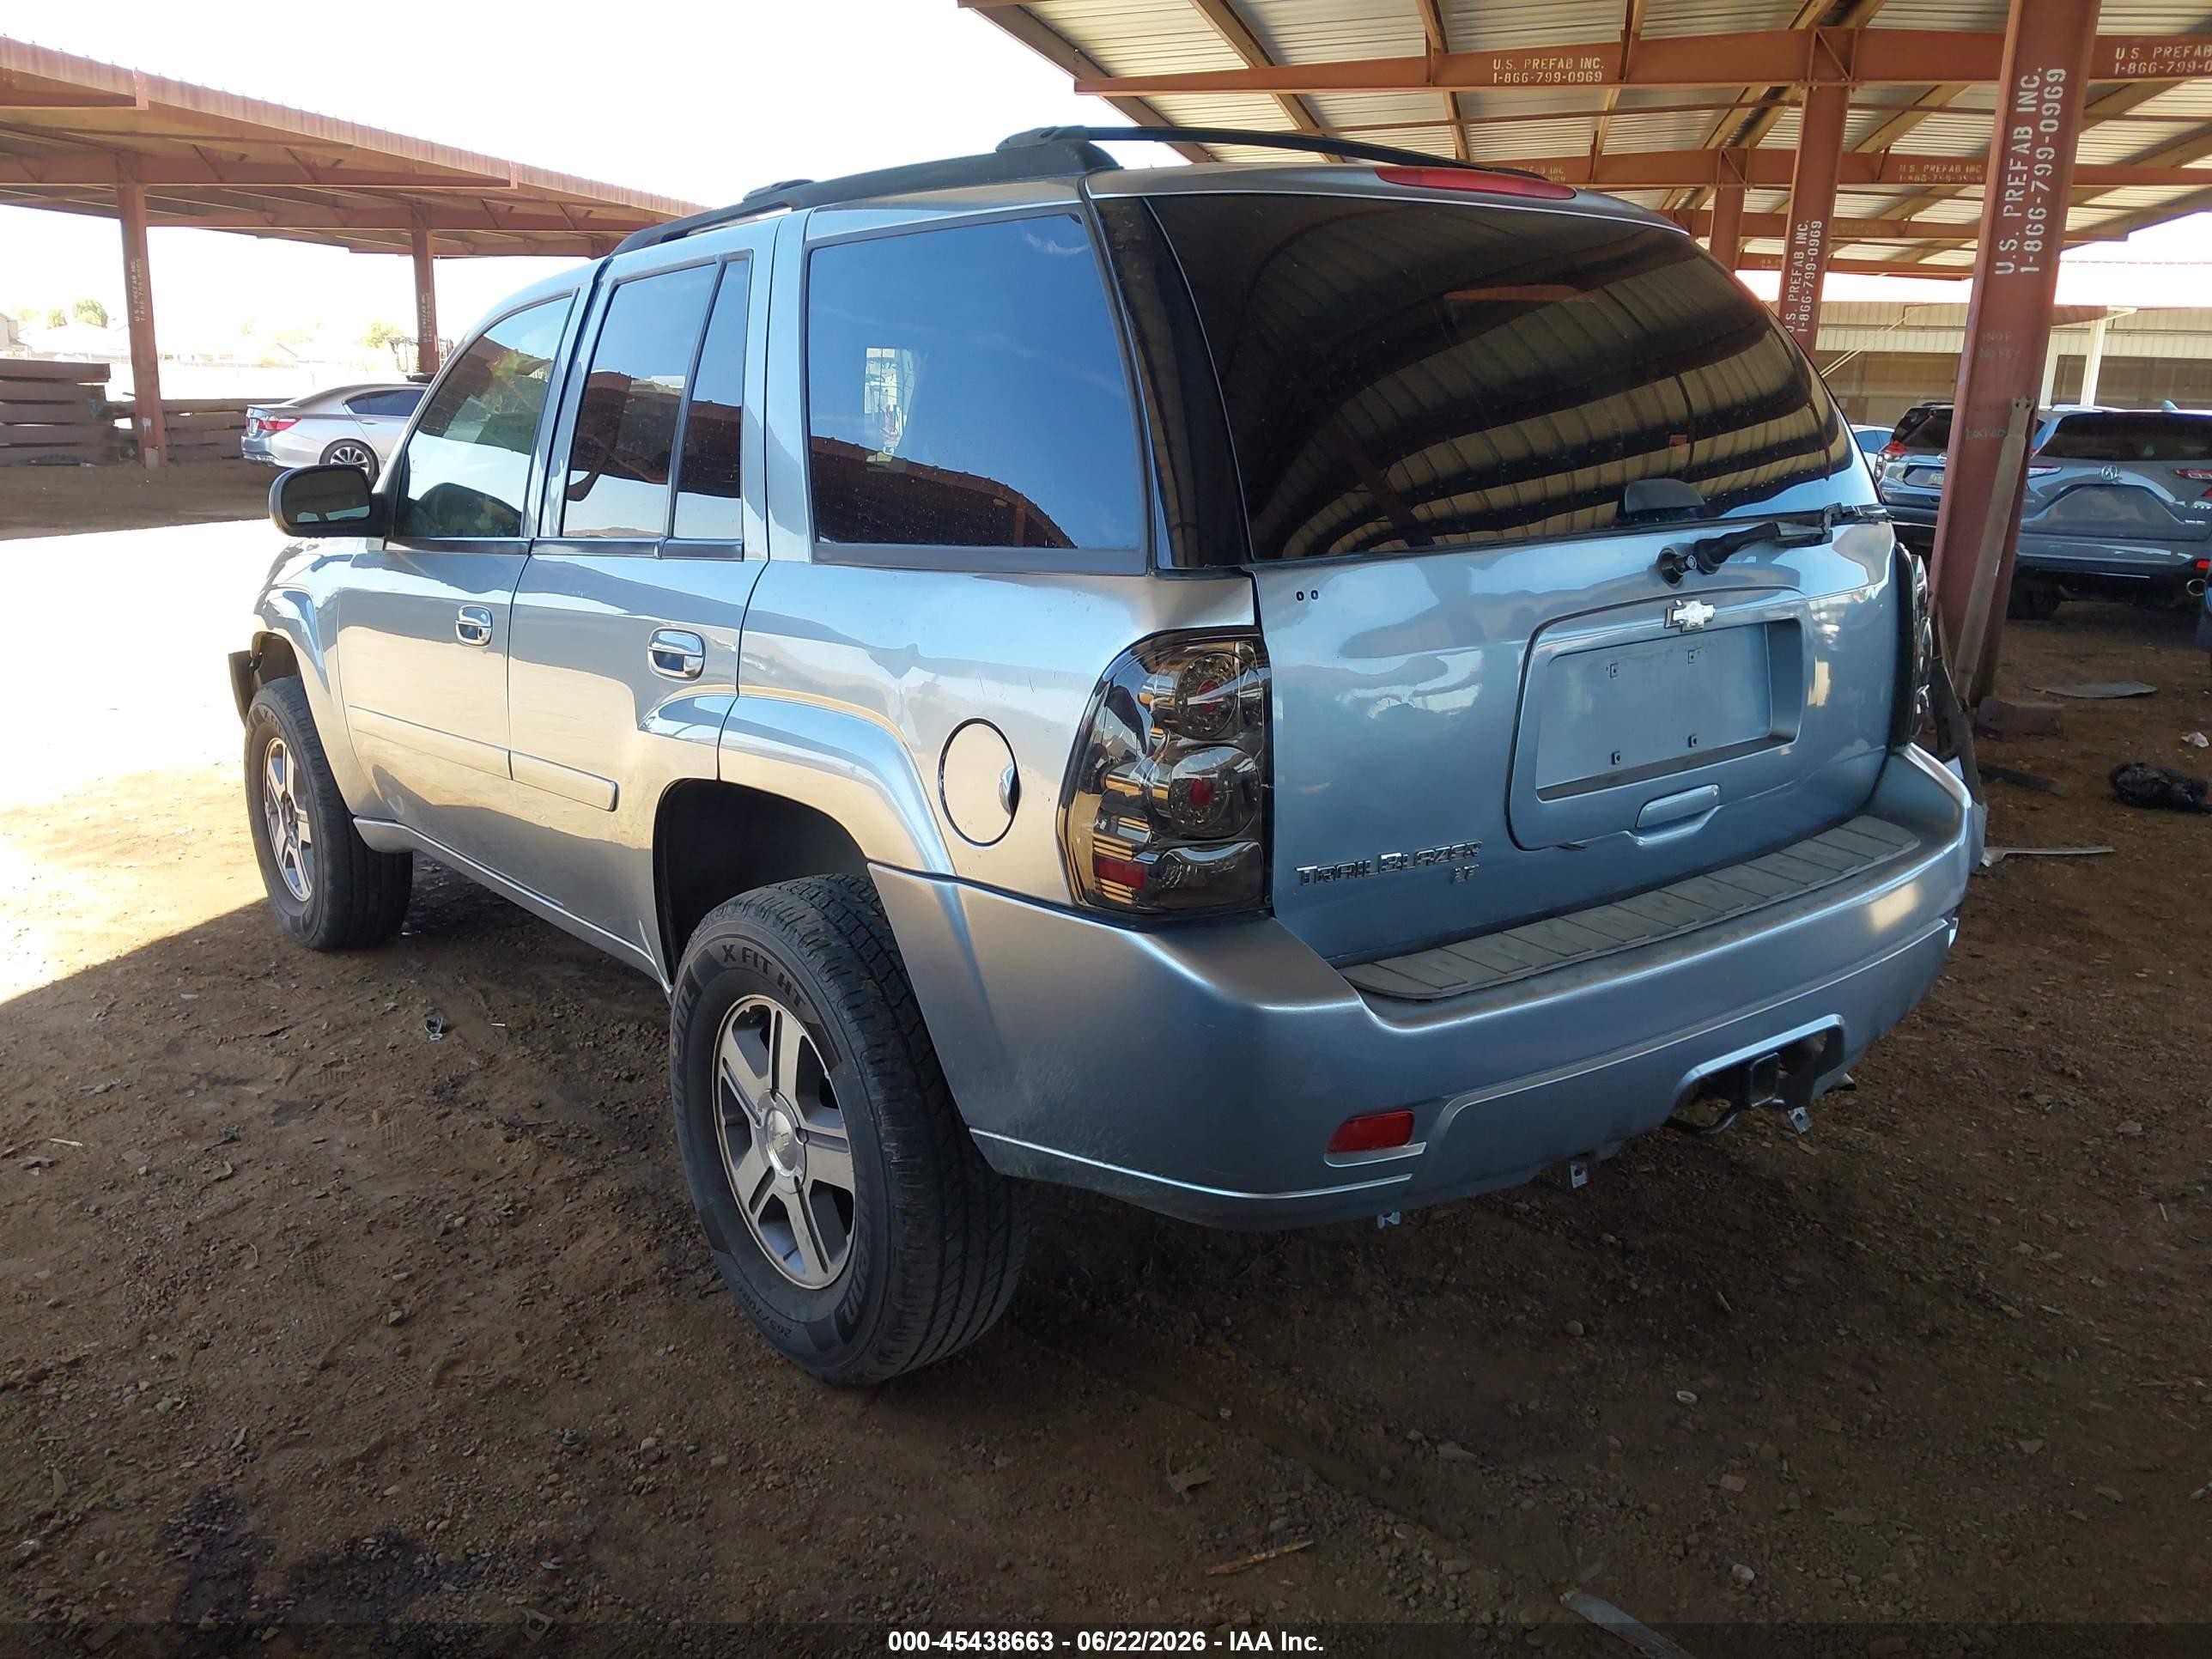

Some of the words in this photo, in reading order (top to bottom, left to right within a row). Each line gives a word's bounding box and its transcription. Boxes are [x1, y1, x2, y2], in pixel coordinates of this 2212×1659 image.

[1493, 58, 1517, 70] U.S.
[1524, 58, 1573, 70] PREFAB
[1580, 57, 1605, 70] INC.
[1493, 70, 1603, 83] 1-866-799-0969
[2153, 44, 2212, 59] PREFAB
[2016, 67, 2042, 112] INC.
[2002, 125, 2033, 217] PREFAB
[2021, 68, 2067, 273] 1-866-799-0969
[1788, 251, 1804, 301] PREFAB
[1796, 220, 1809, 244] INC.
[1797, 220, 1822, 332] 1-866-799-0969
[1995, 231, 2020, 275] U.S.
[722, 945, 737, 963] X
[742, 946, 773, 975] FIT
[777, 972, 806, 1007] HT
